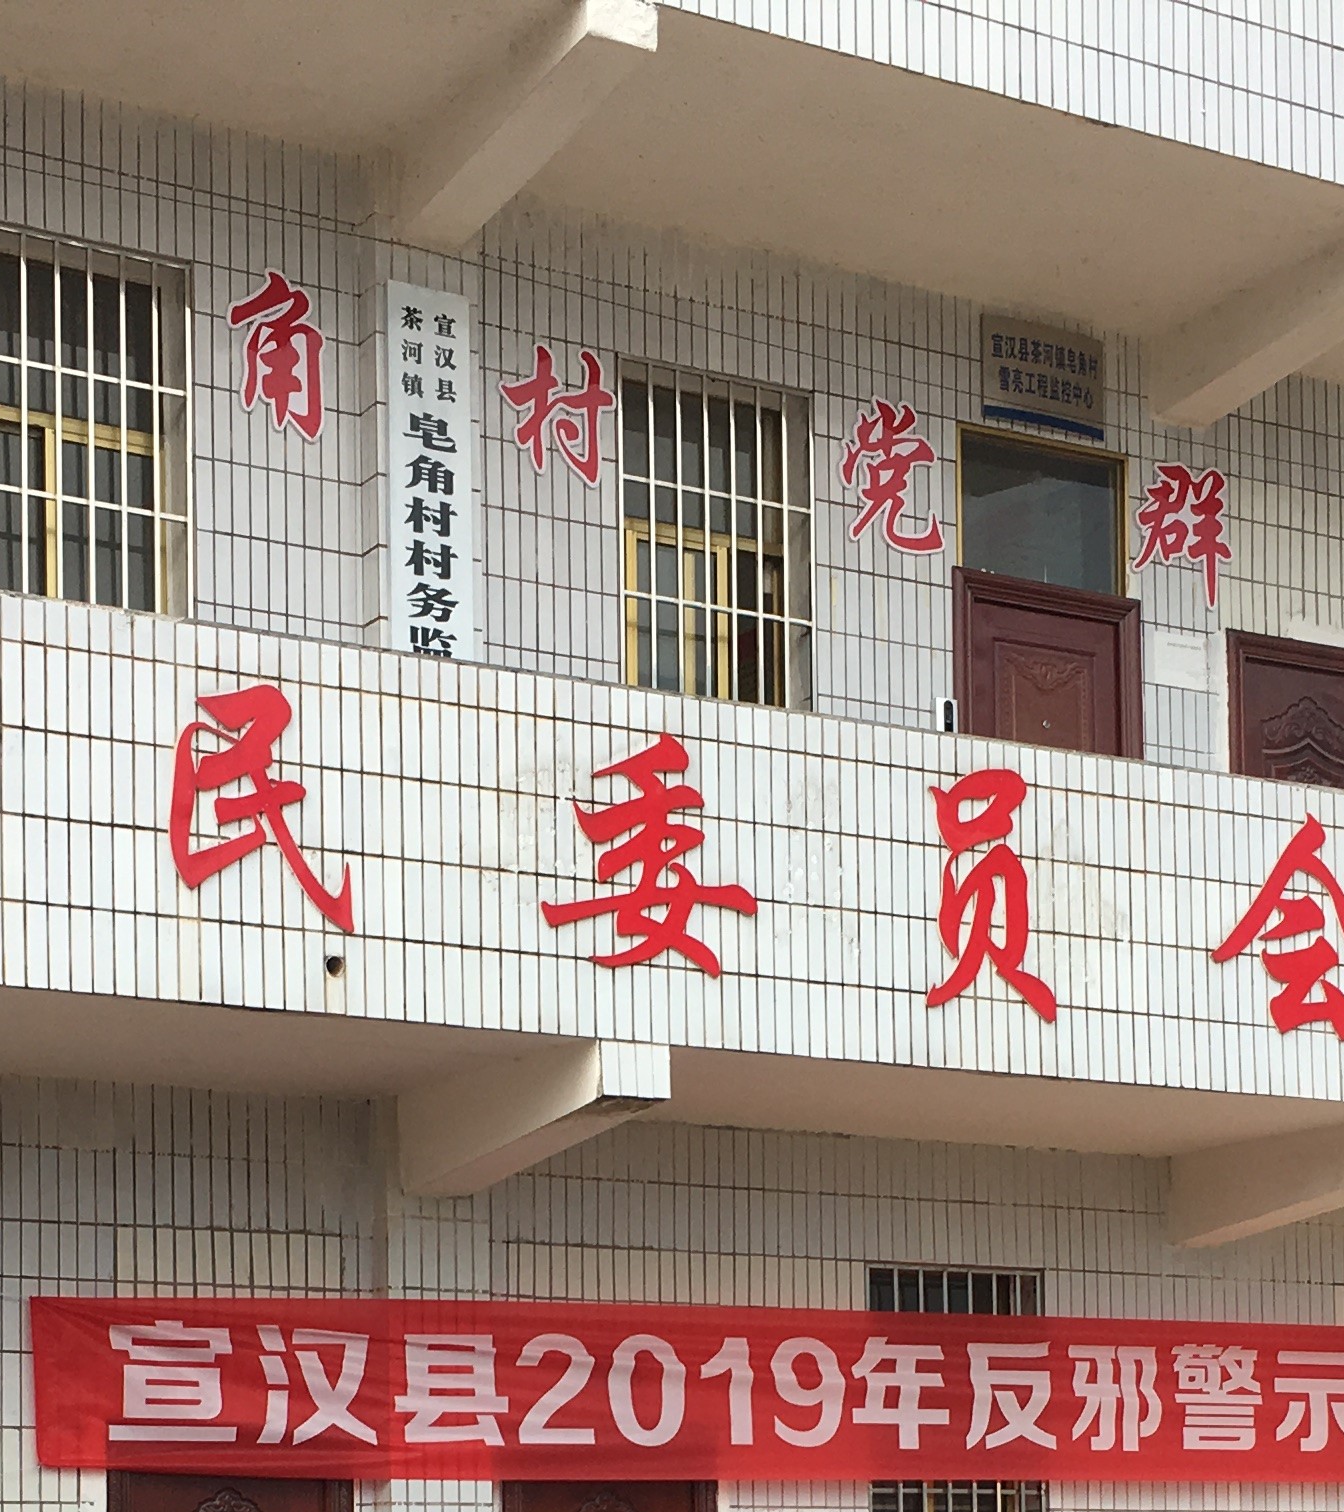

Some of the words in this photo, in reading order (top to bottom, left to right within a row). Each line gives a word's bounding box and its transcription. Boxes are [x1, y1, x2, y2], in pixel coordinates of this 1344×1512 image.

[400, 305, 424, 398] 茶河镇
[433, 313, 457, 403] 宣汉县
[991, 333, 1099, 379] 宣汉县茶河镇皂角村
[999, 365, 1094, 409] 雪亮工程监控中心
[402, 412, 460, 658] 皂角村村务监
